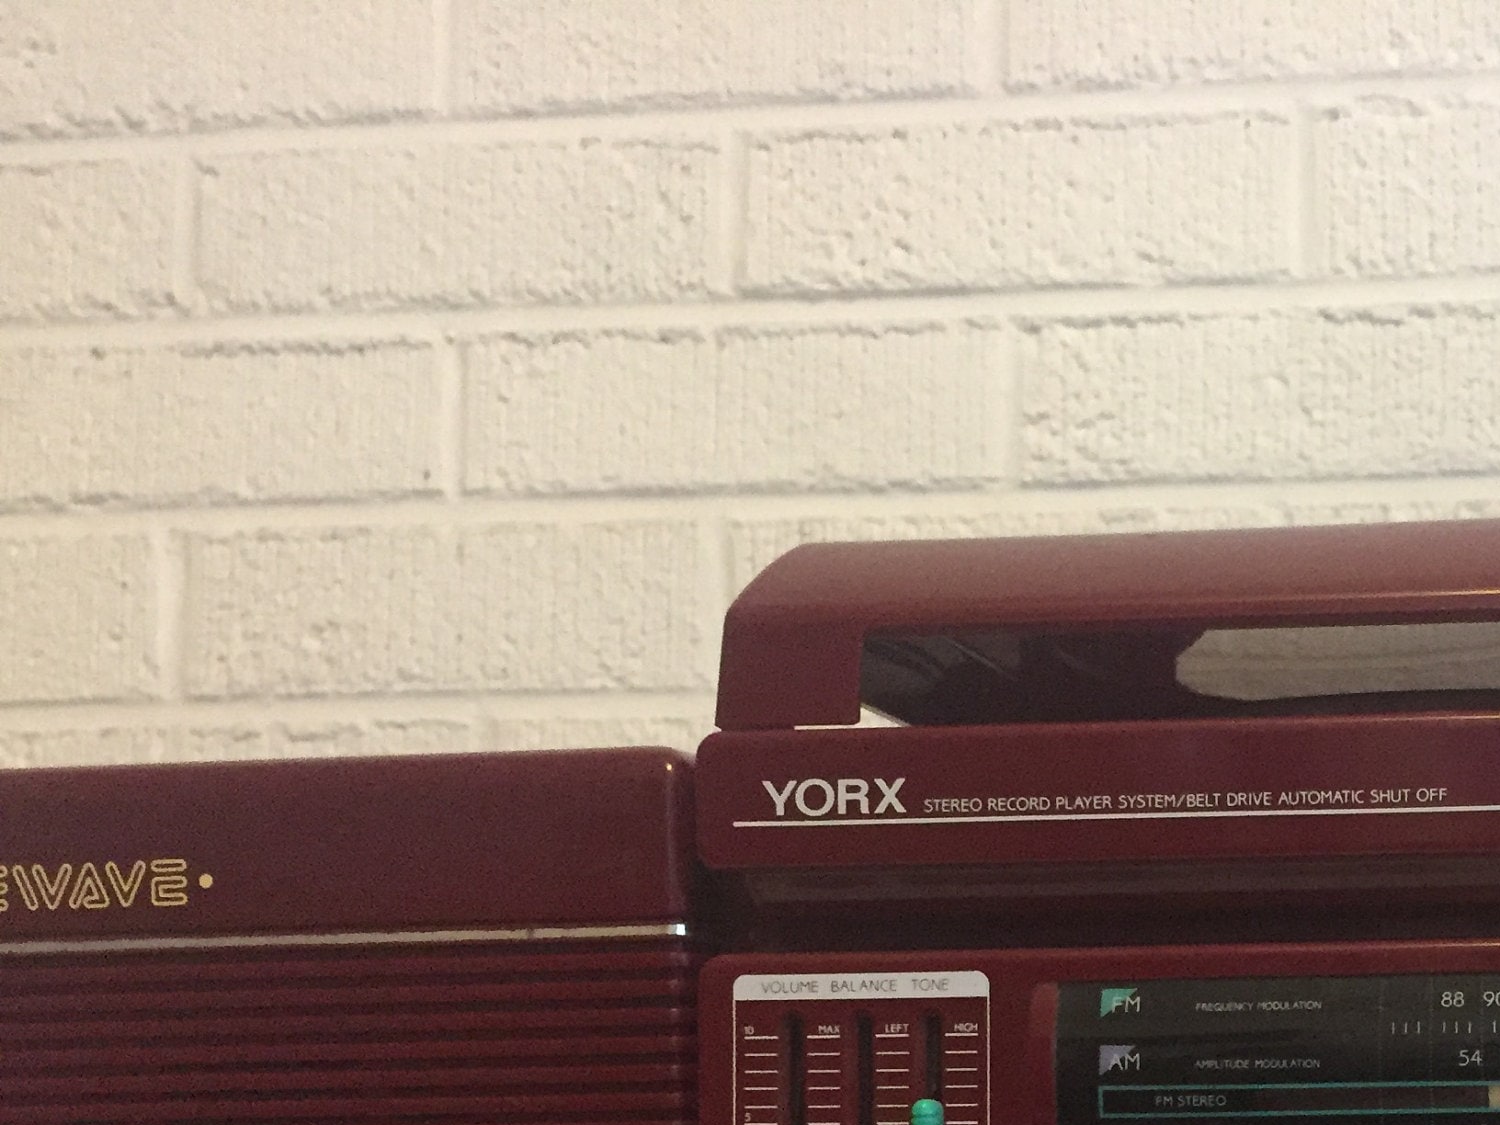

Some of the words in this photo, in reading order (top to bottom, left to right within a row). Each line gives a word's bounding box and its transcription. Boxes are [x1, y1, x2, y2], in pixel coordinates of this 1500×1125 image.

[762, 777, 907, 817] YORX
[924, 798, 983, 813] STEREO
[988, 796, 1050, 812] RECORD
[1055, 795, 1112, 810] PLAYER
[1118, 793, 1221, 809] SYSTEM/BELT
[1227, 791, 1272, 807] DRIVE
[1278, 789, 1365, 806] AUTOMATIC
[1370, 788, 1410, 804] SHUT
[1416, 787, 1447, 802] OFF
[0, 858, 188, 911] WAVE
[761, 980, 819, 994] VOLUME
[831, 979, 897, 993] BALANCE
[912, 978, 949, 992] TONE
[1112, 996, 1141, 1013] FM
[1195, 1002, 1253, 1012] FREQUENCY
[1259, 1000, 1322, 1011] MODULATION
[1440, 991, 1465, 1007] 88
[818, 1025, 840, 1034] MAX
[885, 1023, 909, 1033] LEFT
[954, 1022, 978, 1032] HIGH
[1108, 1053, 1141, 1071] AM
[1194, 1058, 1250, 1069] AMPLITUDE
[1254, 1058, 1321, 1069] MODULATION
[1458, 1049, 1482, 1066] 54
[1156, 1096, 1174, 1107] FM
[1177, 1095, 1227, 1107] STEREO
[745, 1113, 751, 1122] 5
